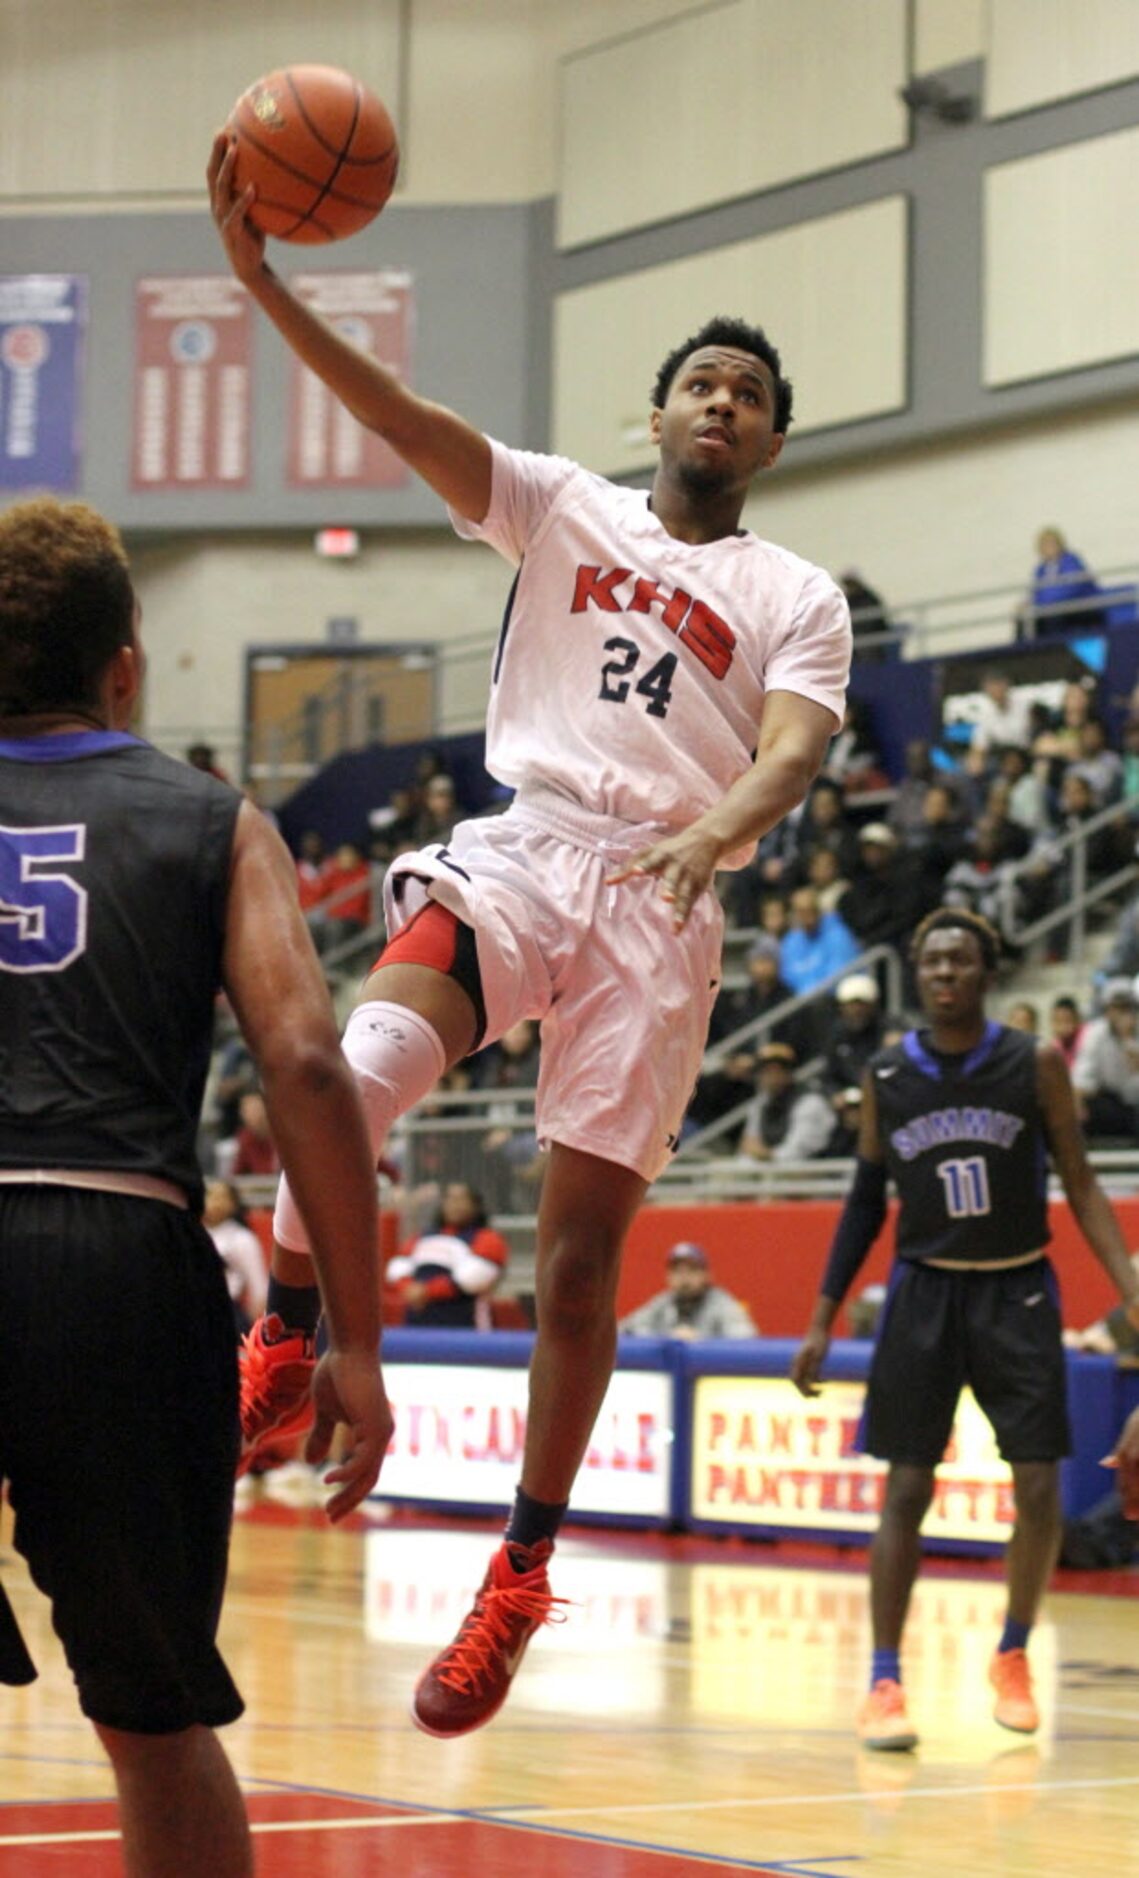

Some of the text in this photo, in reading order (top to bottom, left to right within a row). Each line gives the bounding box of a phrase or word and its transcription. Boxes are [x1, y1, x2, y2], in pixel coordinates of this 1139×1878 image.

[570, 564, 737, 680] KHS
[598, 636, 678, 719] 24
[0, 823, 88, 974] 5
[891, 1107, 1026, 1161] SUMMIT
[936, 1156, 991, 1219] 11
